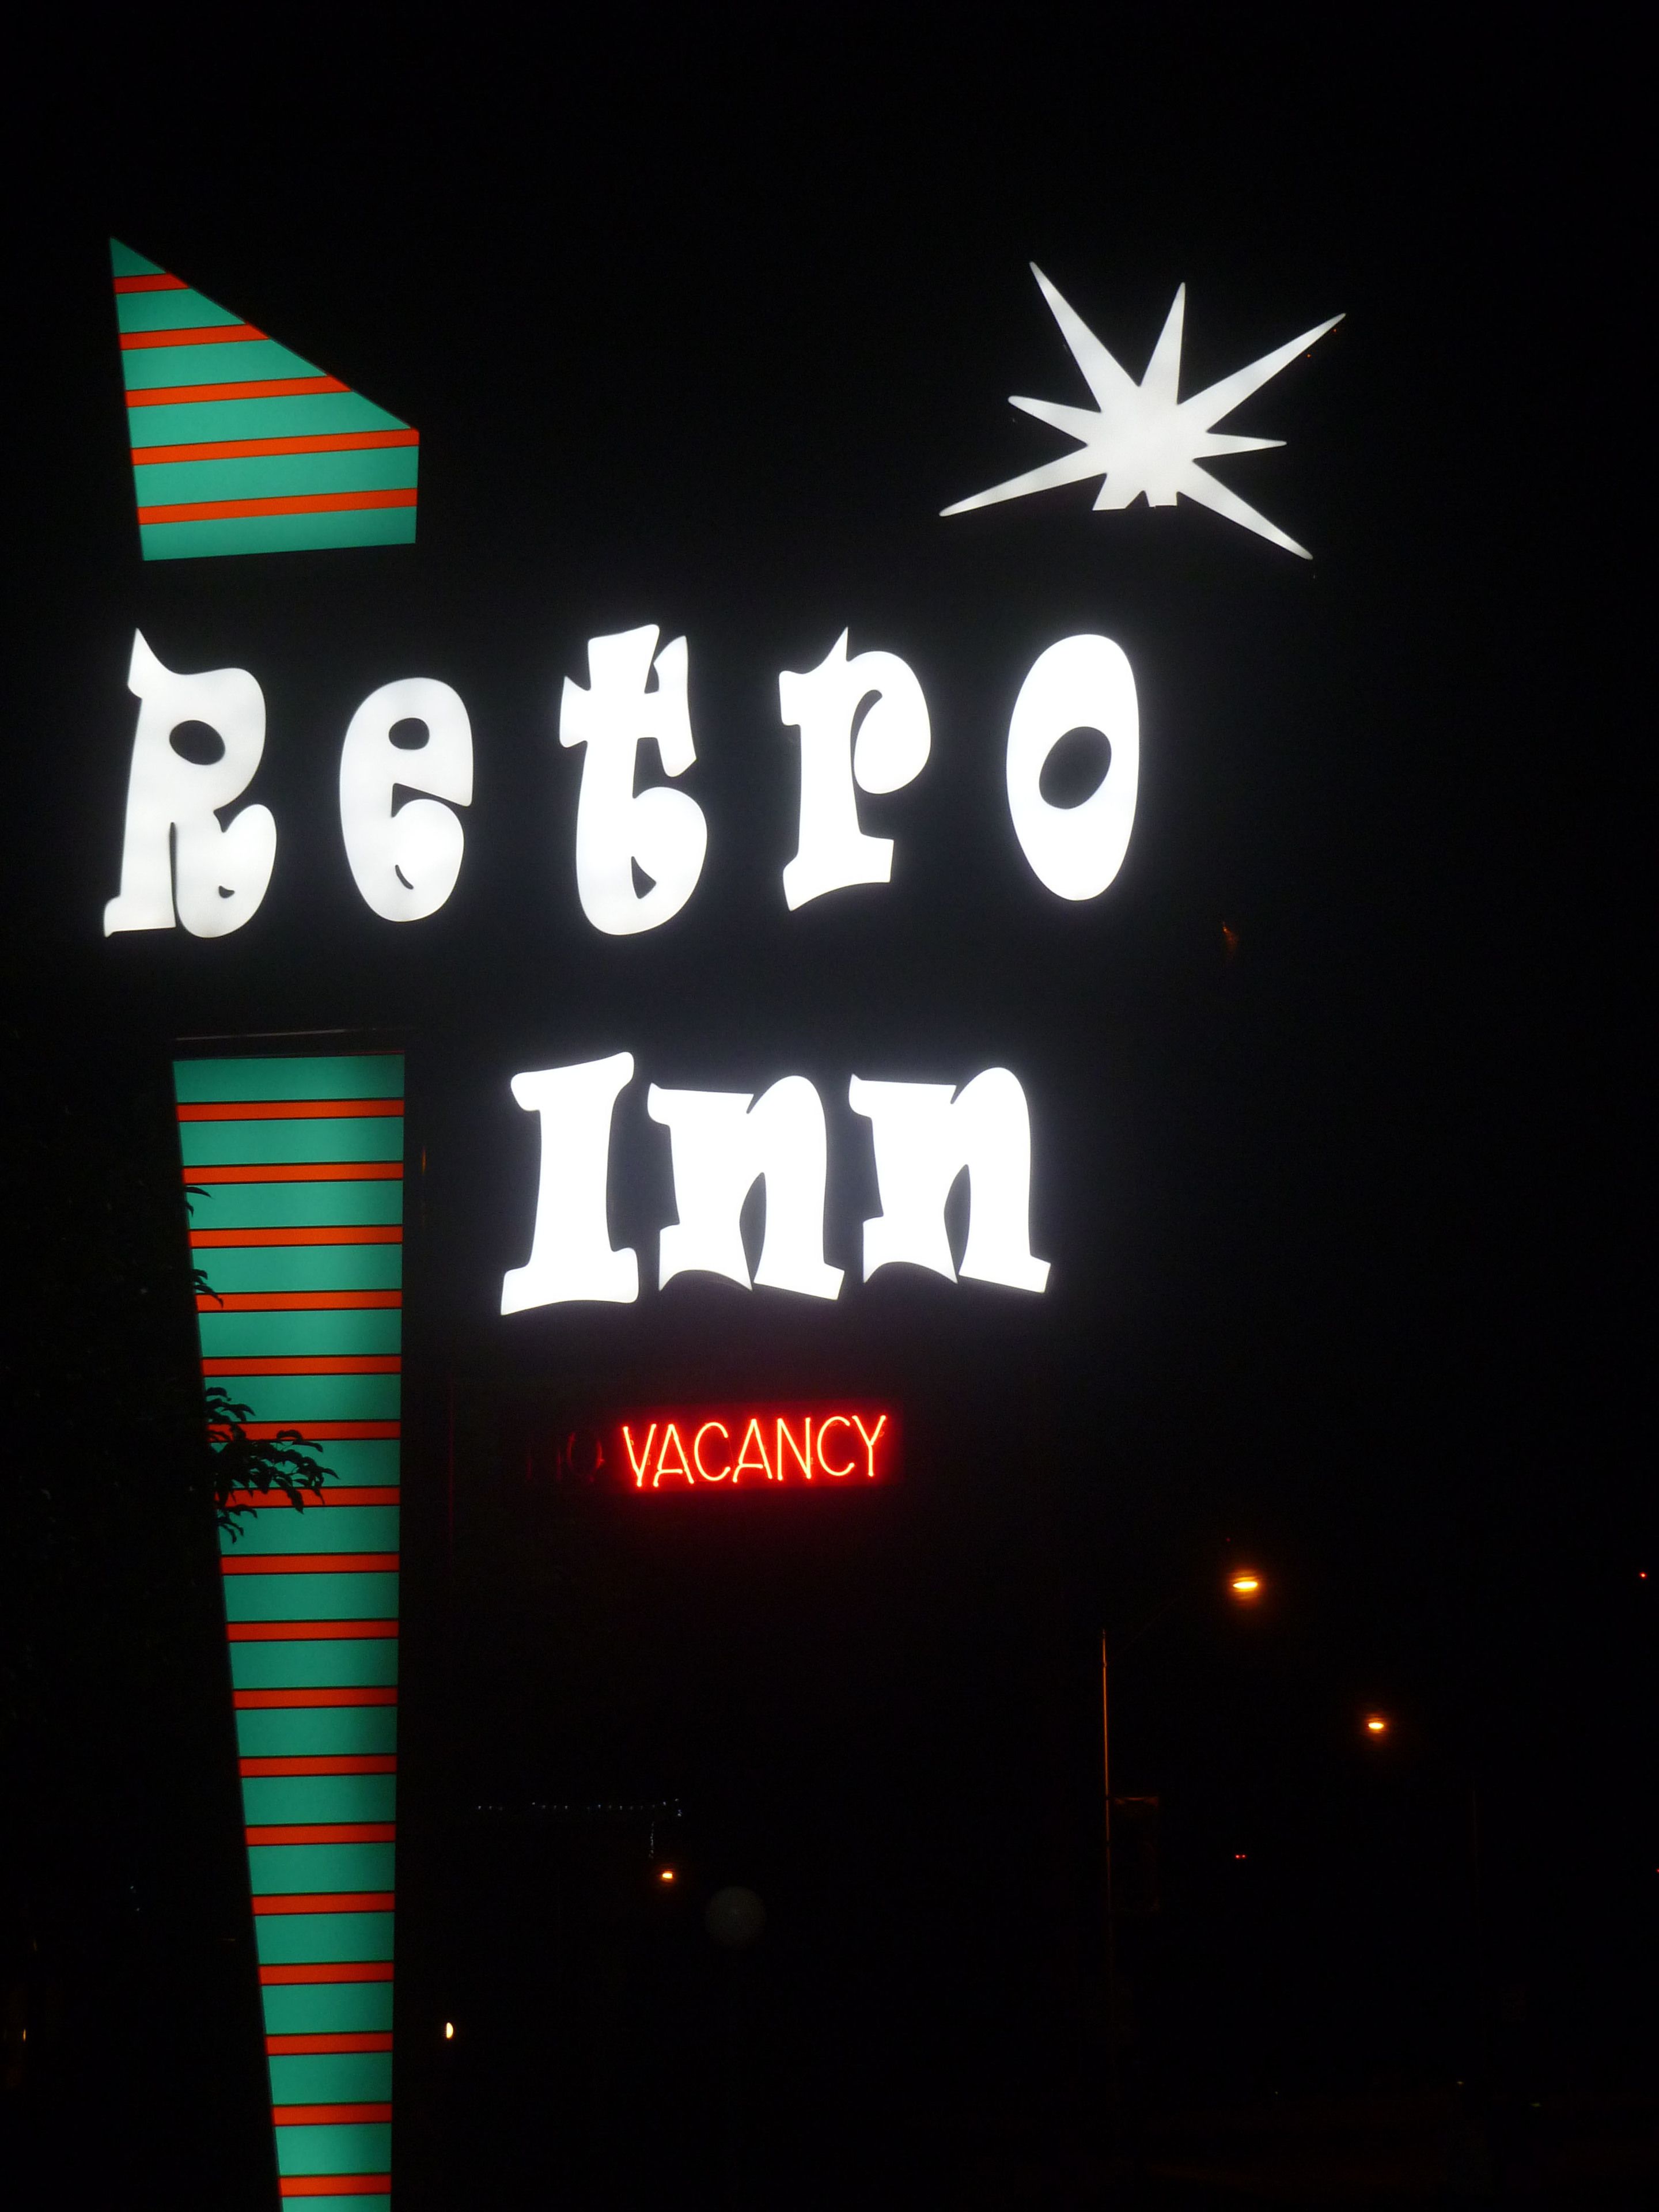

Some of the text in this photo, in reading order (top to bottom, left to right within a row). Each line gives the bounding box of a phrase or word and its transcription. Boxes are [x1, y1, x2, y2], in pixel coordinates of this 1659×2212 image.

[104, 624, 1139, 937] Retro
[501, 1052, 1051, 1315] Inn
[620, 1411, 889, 1491] VACANCY
